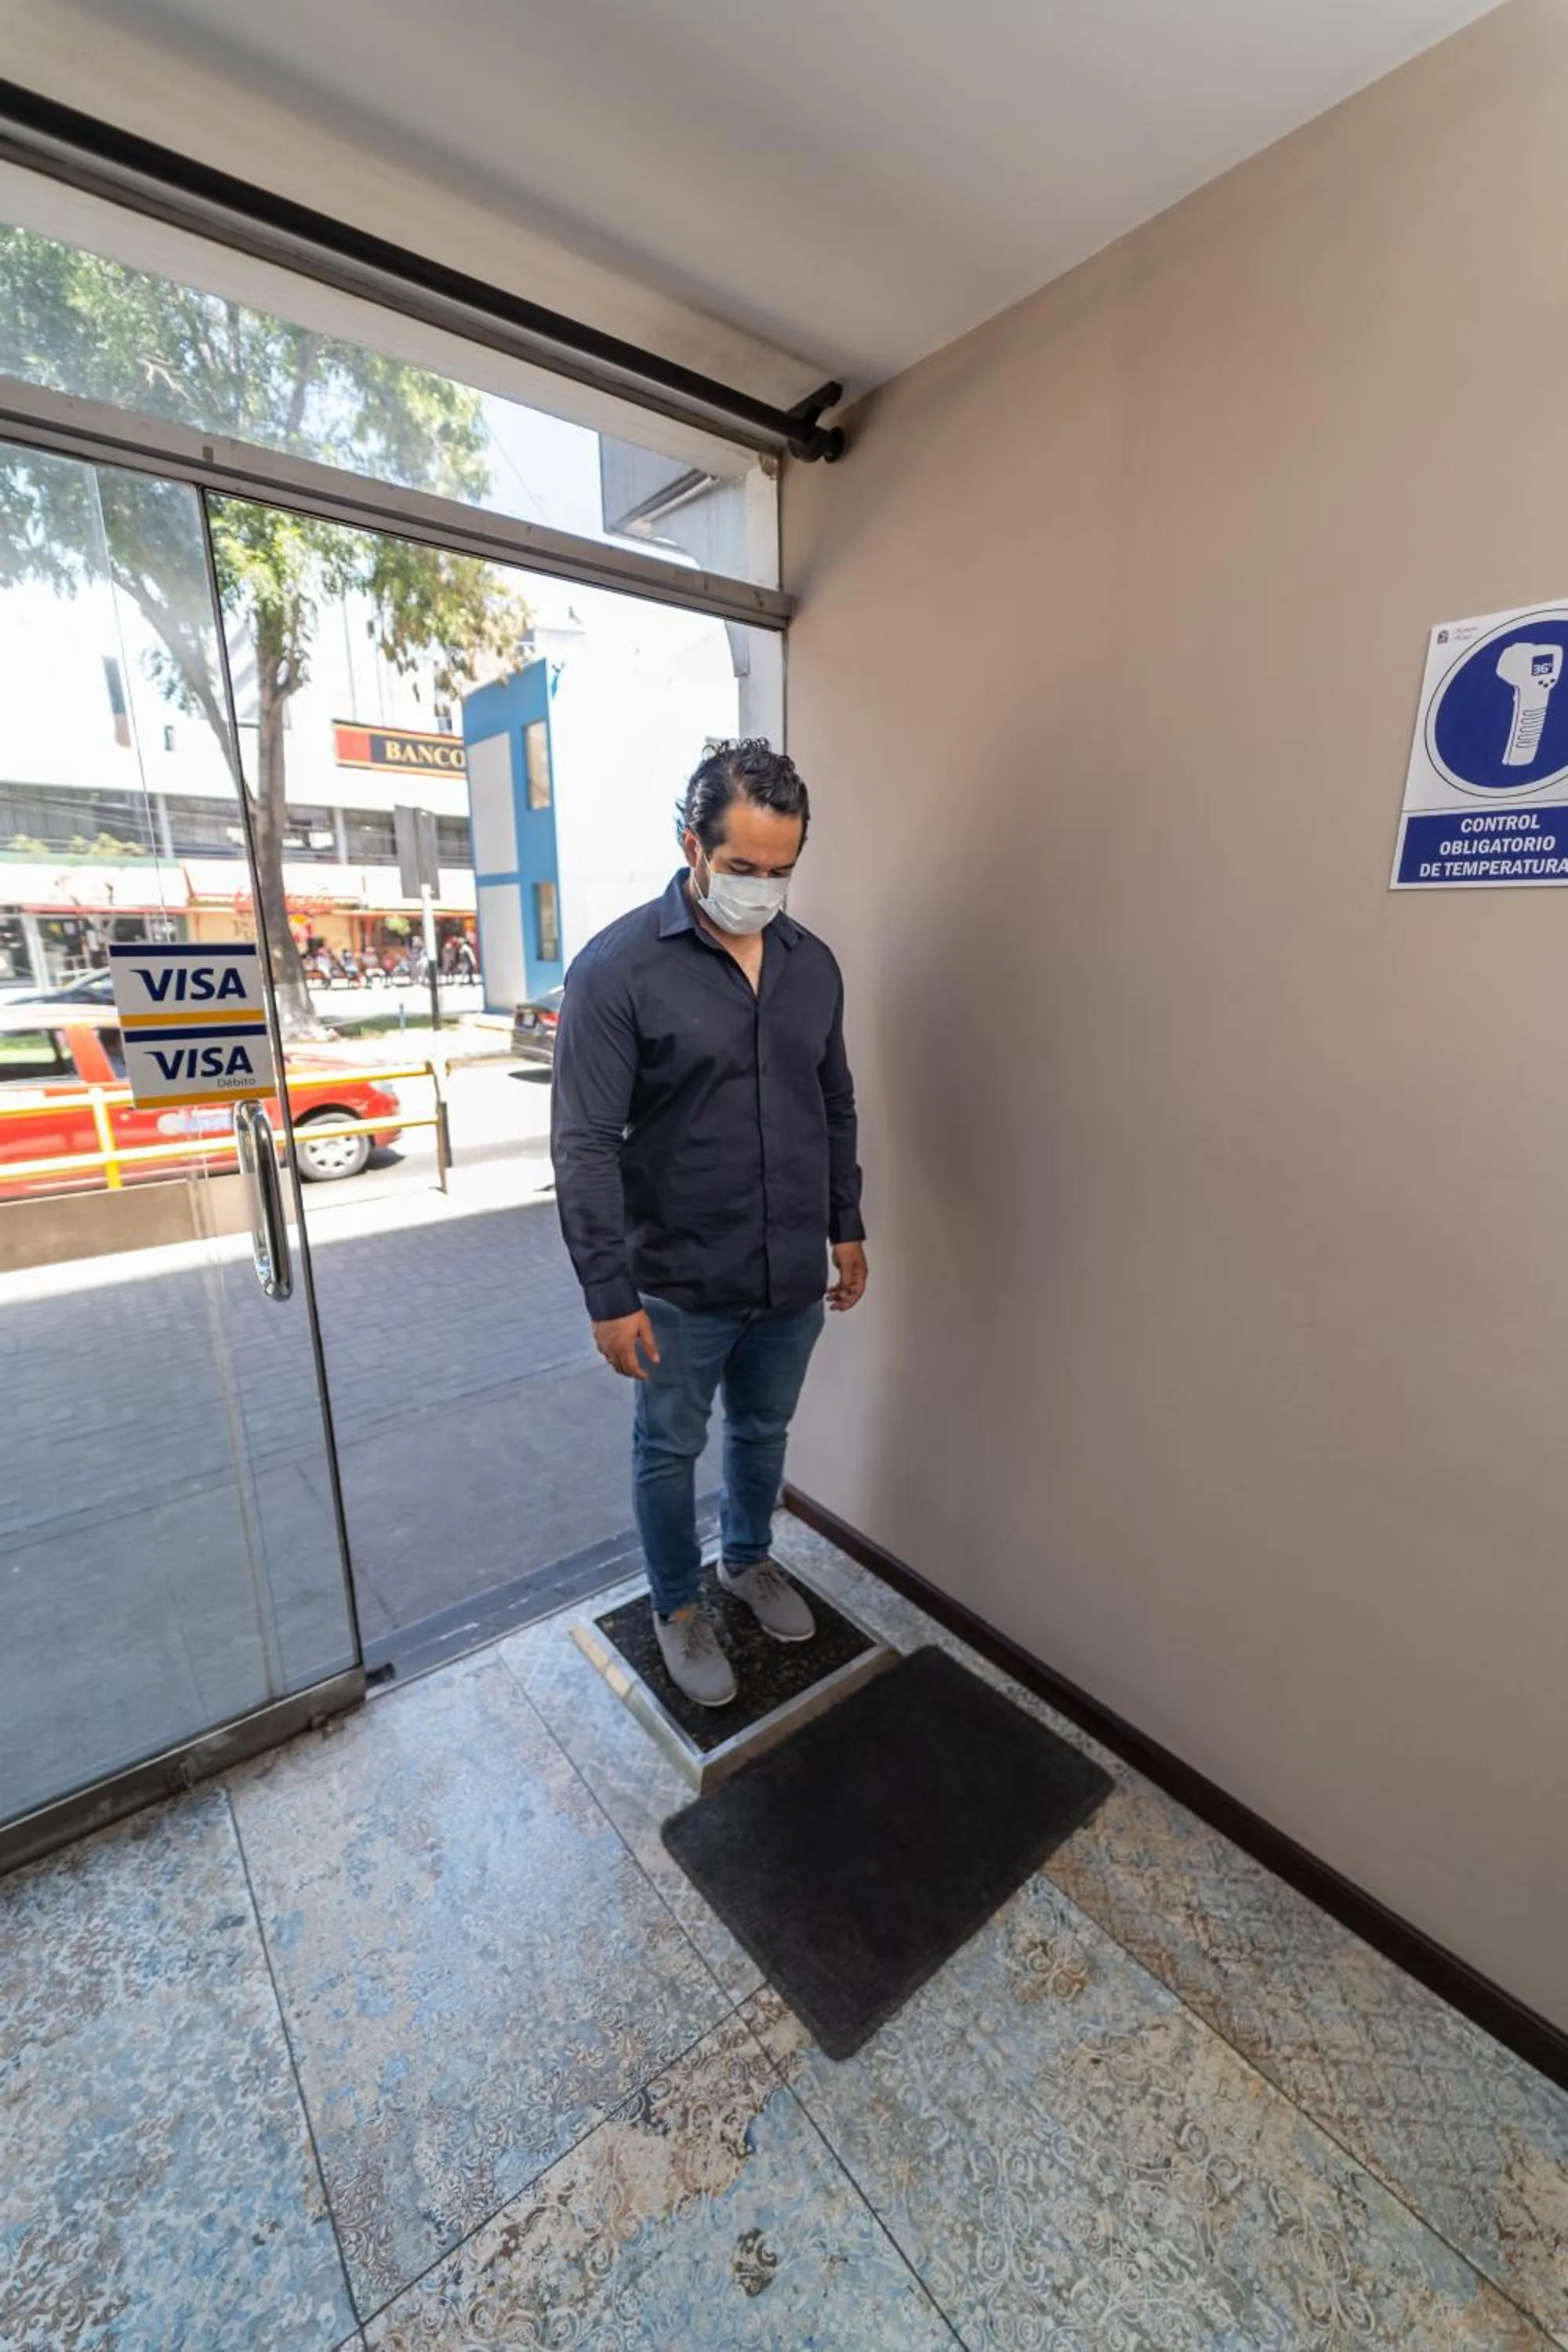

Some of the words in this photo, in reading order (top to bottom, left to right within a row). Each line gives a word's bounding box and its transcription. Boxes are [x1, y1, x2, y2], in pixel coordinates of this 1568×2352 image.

[385, 740, 466, 768] BANCO
[1461, 814, 1540, 833] CONTROL
[1439, 836, 1555, 855] OBLIGATORIO
[1420, 863, 1442, 877] DE
[1445, 858, 1568, 877] TEMPERATURA
[129, 967, 247, 1001] VISA
[143, 1046, 253, 1080] VISA
[217, 1078, 256, 1088] Débito
